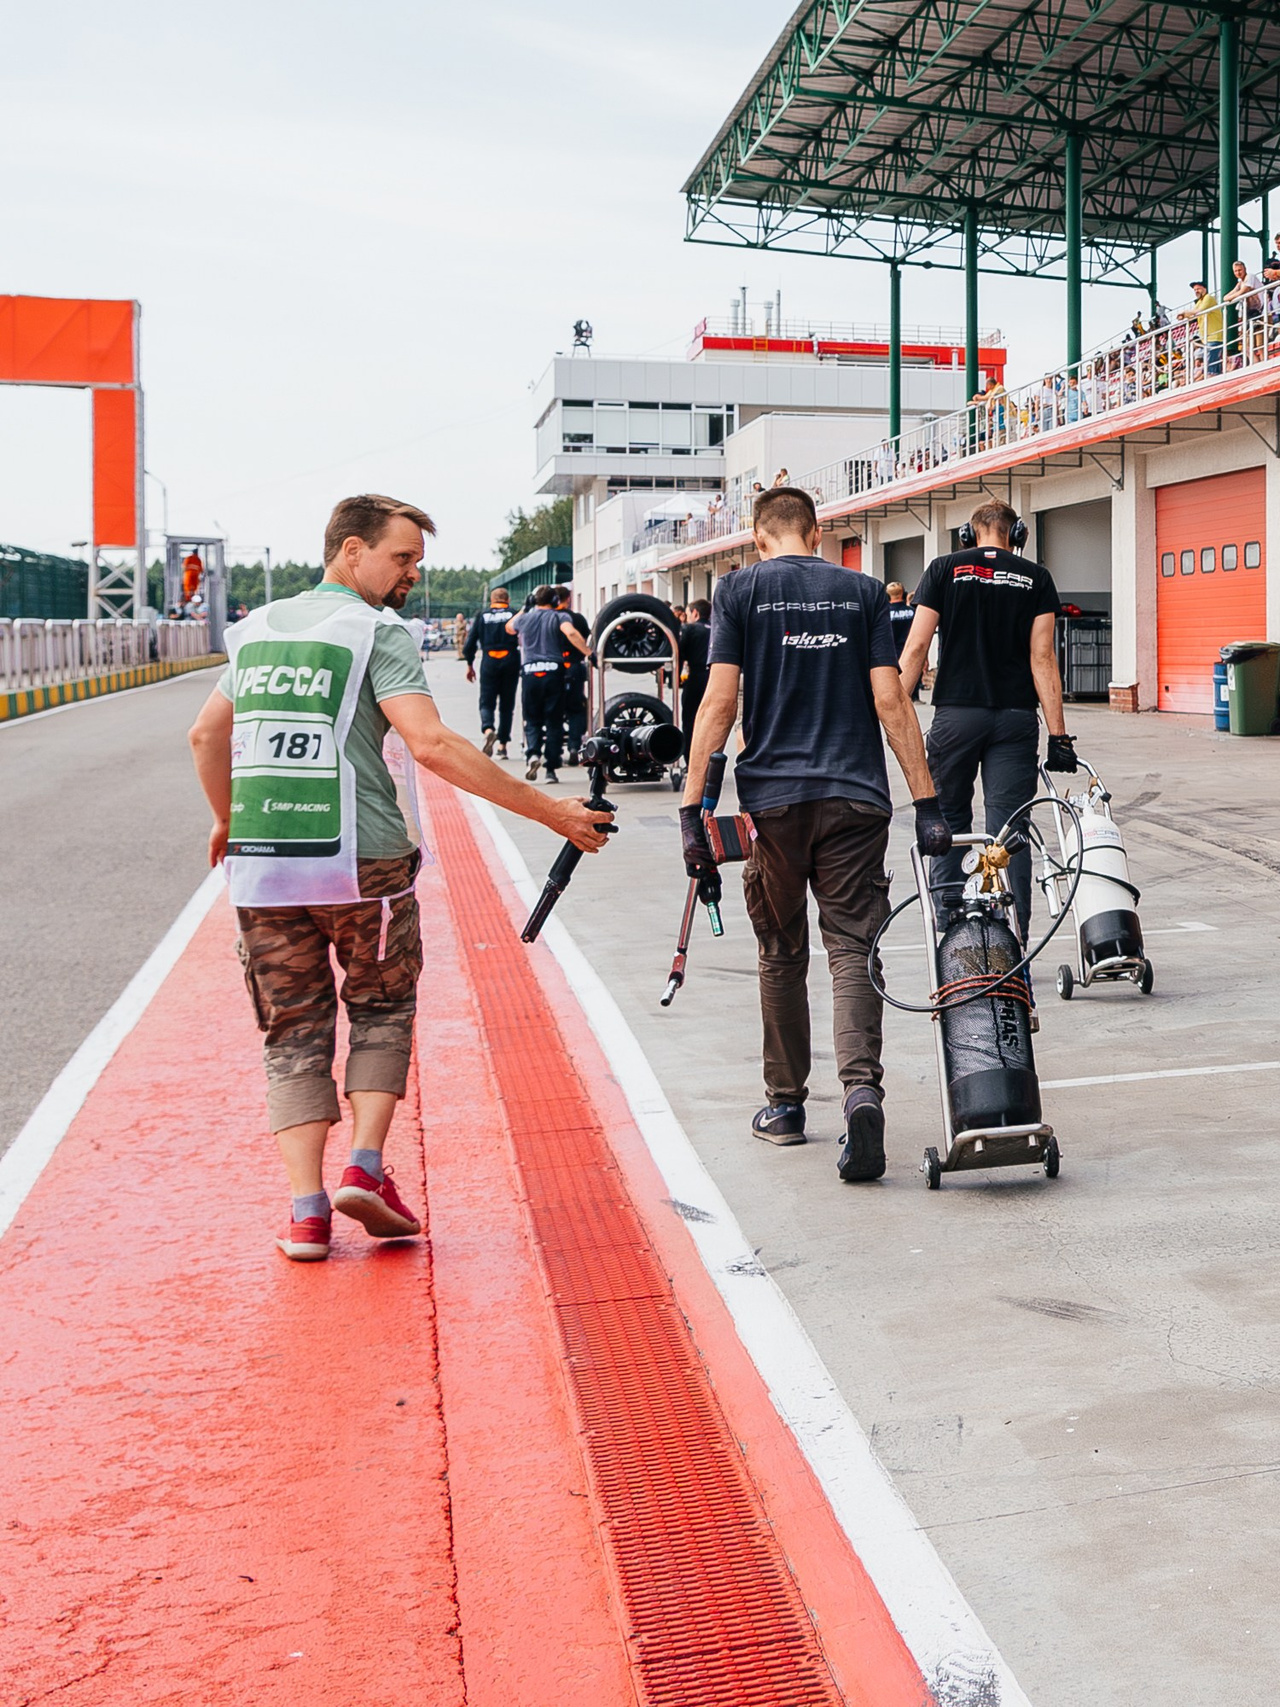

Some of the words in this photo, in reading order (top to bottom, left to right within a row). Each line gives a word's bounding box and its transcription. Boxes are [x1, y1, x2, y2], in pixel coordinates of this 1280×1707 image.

[268, 732, 321, 760] 187
[271, 802, 293, 812] SMP
[293, 803, 330, 813] RACING
